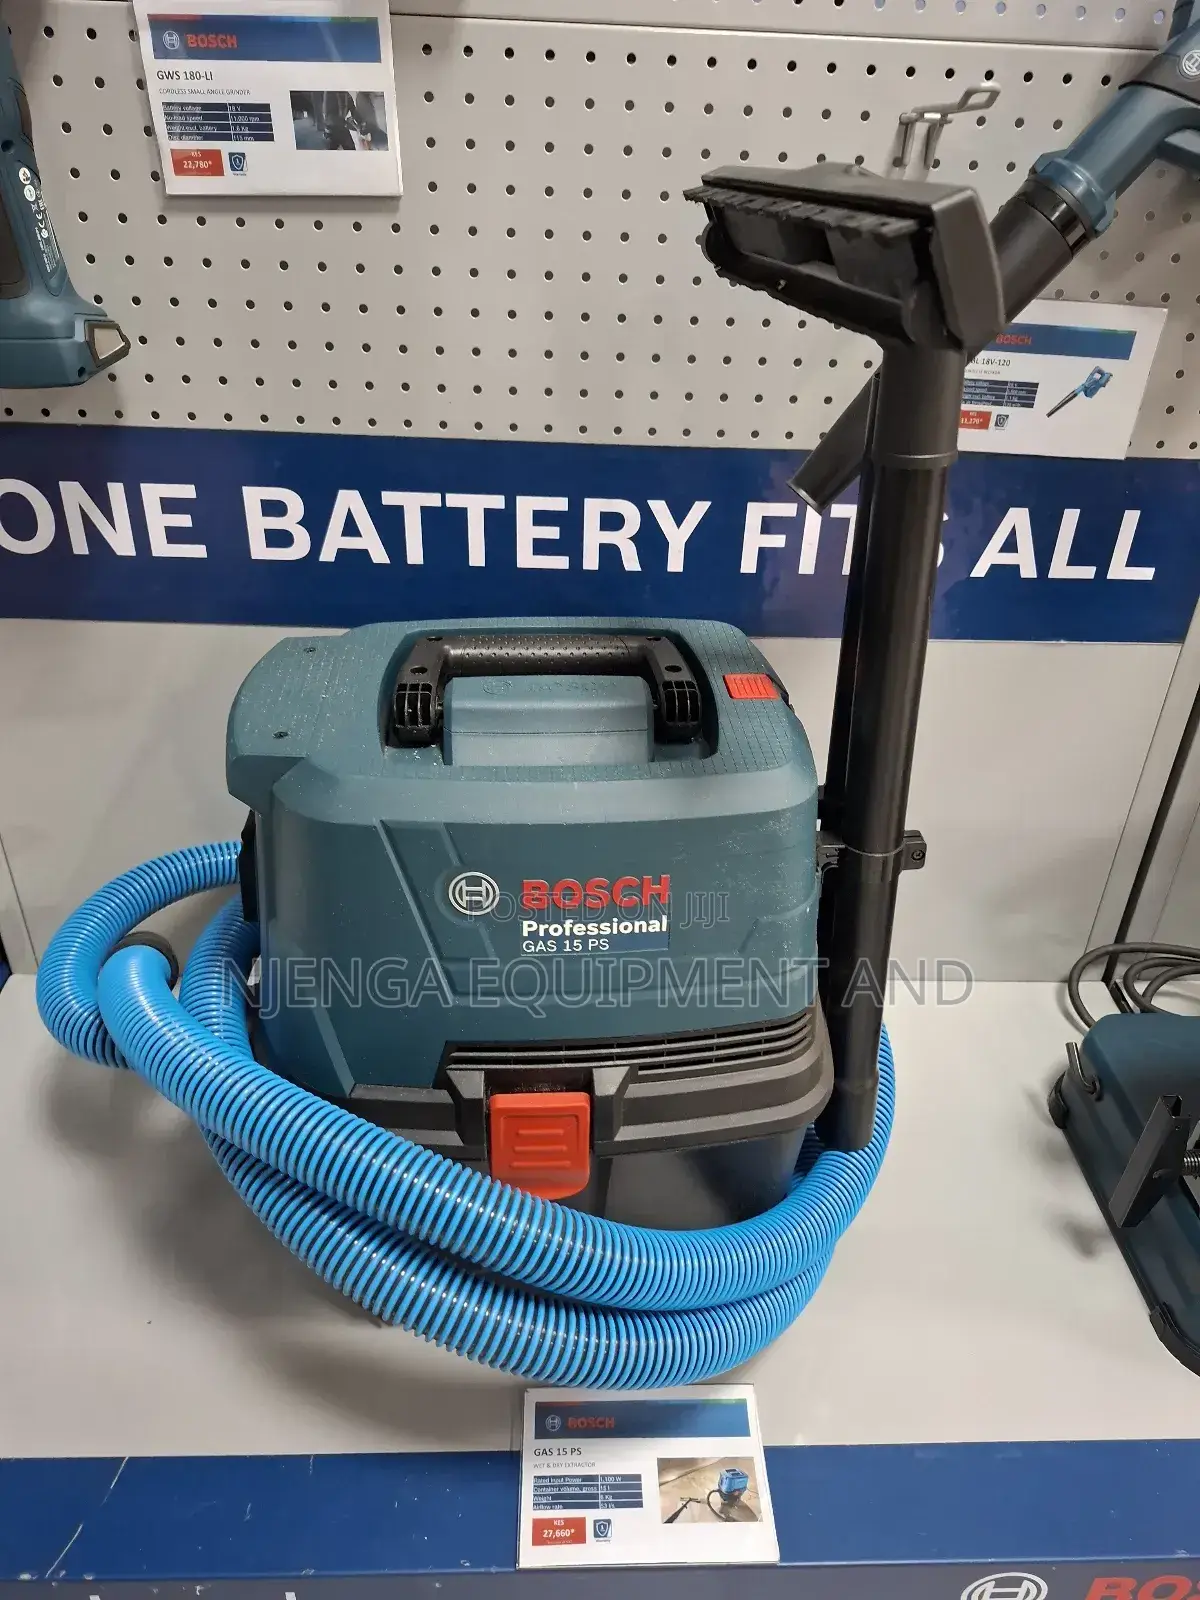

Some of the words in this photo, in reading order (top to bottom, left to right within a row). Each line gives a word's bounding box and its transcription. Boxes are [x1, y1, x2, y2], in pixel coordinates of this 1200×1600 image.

[187, 34, 238, 49] BOSCH
[156, 70, 181, 81] GWS
[183, 71, 213, 82] 180-LI
[159, 87, 187, 95] CORDLESS
[981, 358, 1011, 367] 18V-120
[0, 478, 208, 559] ONE
[242, 486, 712, 573] BATTERY
[970, 507, 1157, 580] ALL
[522, 874, 671, 911] BOSCH
[522, 914, 668, 937] Professional
[522, 940, 557, 953] GAS
[563, 939, 583, 952] 15
[588, 938, 610, 950] PS
[567, 1416, 616, 1430] BOSCH
[533, 1448, 554, 1457] GAS
[556, 1448, 568, 1456] 15
[570, 1447, 582, 1456] PS
[1085, 1574, 1200, 1600] BO
